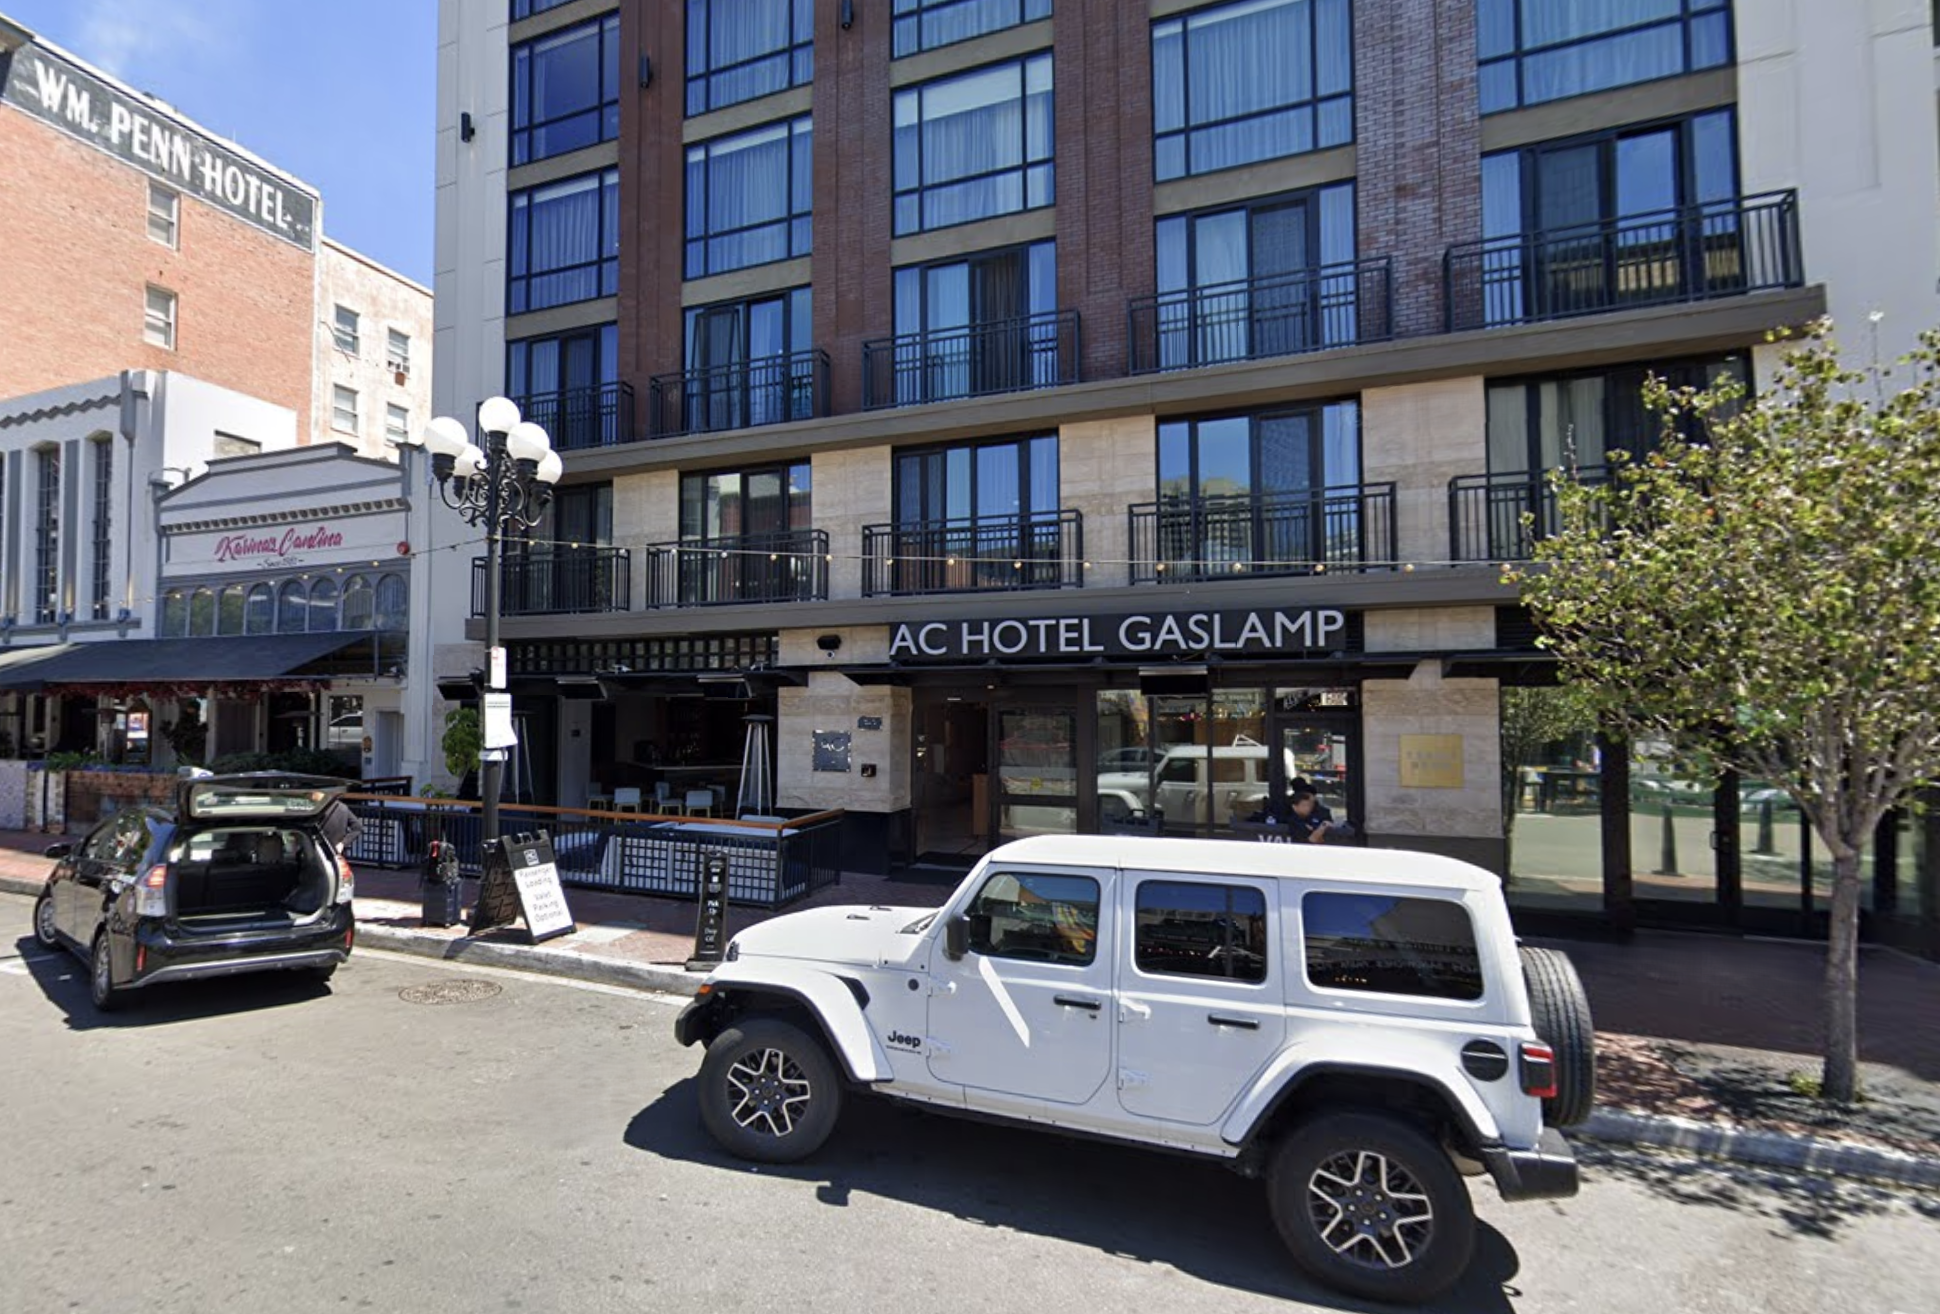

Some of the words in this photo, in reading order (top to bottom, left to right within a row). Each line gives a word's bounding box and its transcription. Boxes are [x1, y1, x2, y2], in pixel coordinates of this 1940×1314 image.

[34, 58, 98, 133] WM.
[110, 101, 192, 180] PENN
[201, 152, 290, 230] HOTEL
[889, 623, 947, 656] AC
[961, 618, 1105, 655] HOTEL
[1118, 609, 1345, 652] GASLAMP
[887, 1030, 921, 1048] Jeep
